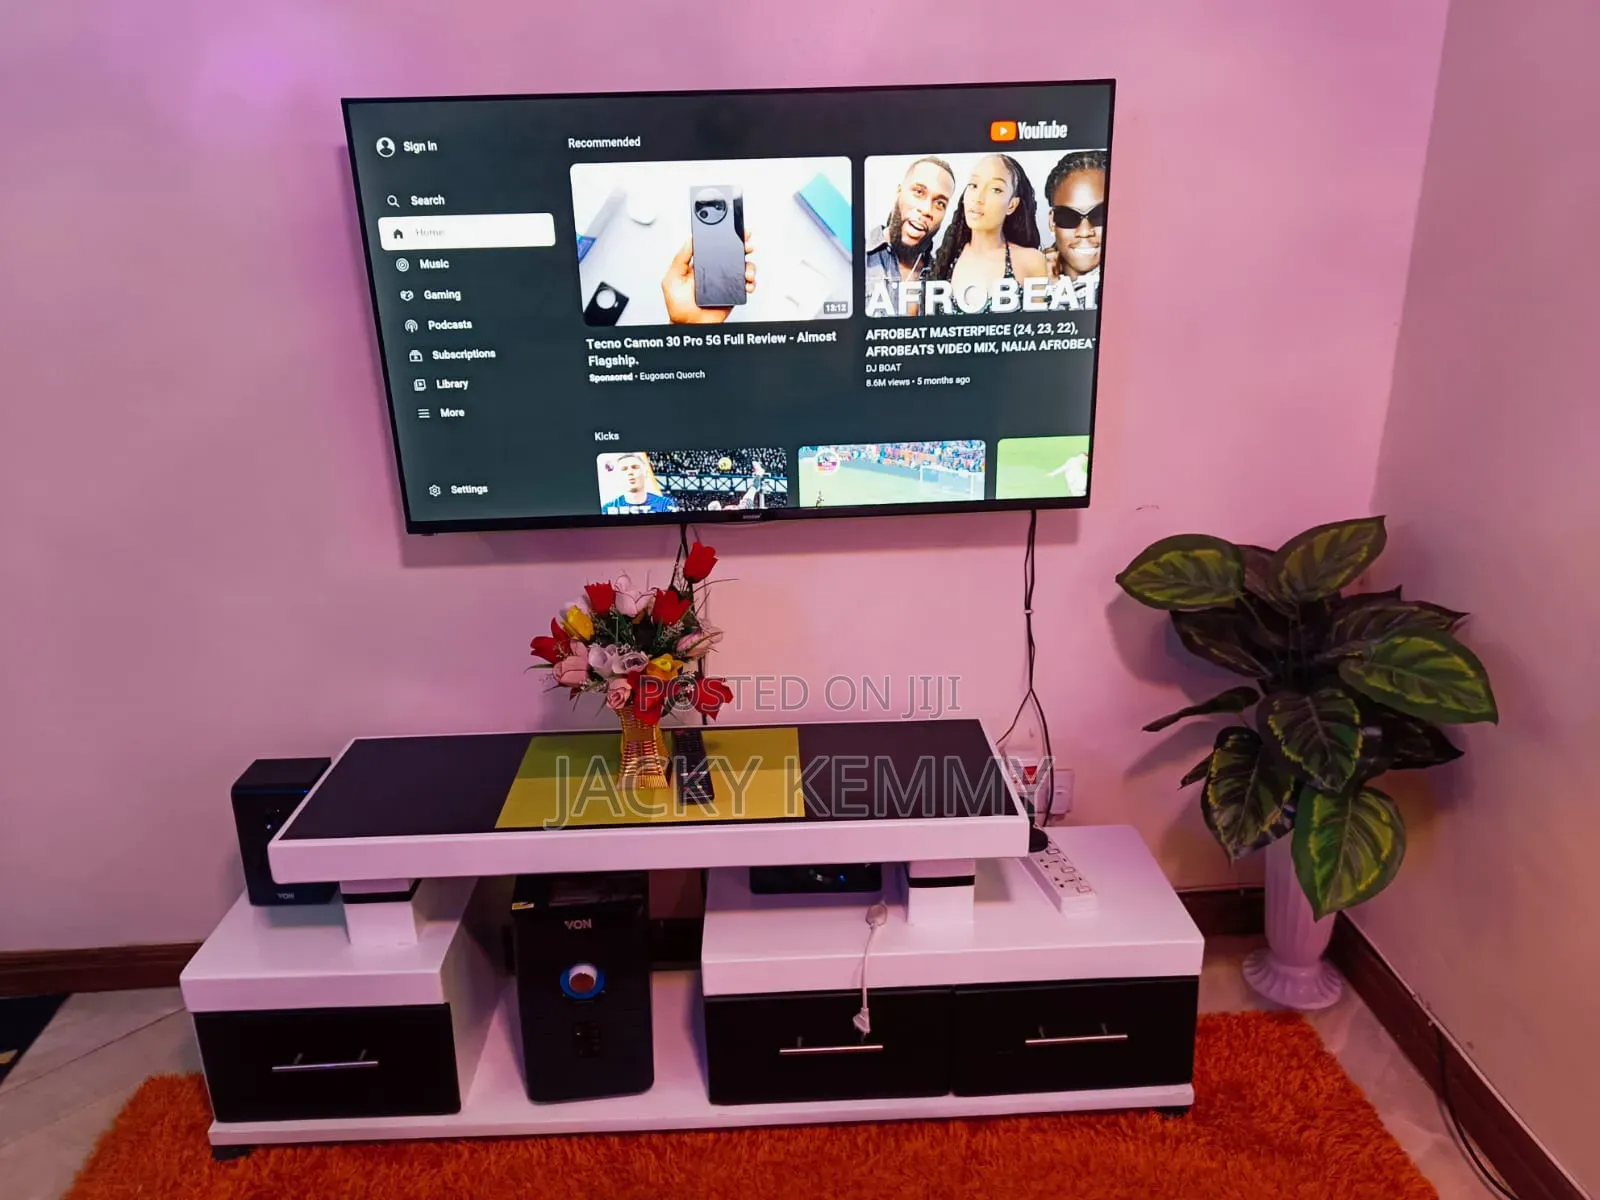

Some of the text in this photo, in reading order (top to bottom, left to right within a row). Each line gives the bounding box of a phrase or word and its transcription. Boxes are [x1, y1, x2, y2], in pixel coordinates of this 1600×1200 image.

[1018, 120, 1067, 139] YouTube
[404, 141, 437, 153] Sign In
[568, 136, 640, 148] Recommended
[411, 195, 445, 205] Search
[420, 259, 449, 269] Music
[424, 290, 461, 301] Gaming
[428, 320, 472, 330] Podcasts
[866, 322, 1078, 340] AFROBEAT MASTERPIECE (24, 23, 22),
[586, 339, 621, 349] Tecno
[624, 338, 663, 348] Camon
[666, 336, 680, 347] 30
[683, 336, 703, 346] Pro
[706, 335, 721, 345] 5G
[724, 334, 744, 345] Full
[747, 333, 786, 344] Review
[797, 331, 836, 342] Almost
[866, 344, 934, 357] AFROBEATS
[937, 343, 971, 354] VIDEO
[974, 342, 998, 354] MIX,
[1002, 340, 1036, 352] NAIJA
[432, 349, 496, 360] Subscriptions
[589, 355, 639, 368] Flagship.
[866, 363, 901, 372] DJ BOAT
[589, 370, 705, 382] Sponsored Eugoson Quorch
[866, 379, 886, 387] 8.6M
[917, 377, 922, 385] 5
[924, 376, 953, 384] months
[956, 377, 970, 385] ago
[436, 379, 468, 390] Library
[440, 408, 464, 417] More
[595, 432, 619, 440] Kicks
[451, 485, 488, 495] Settings
[564, 918, 592, 930] VON
